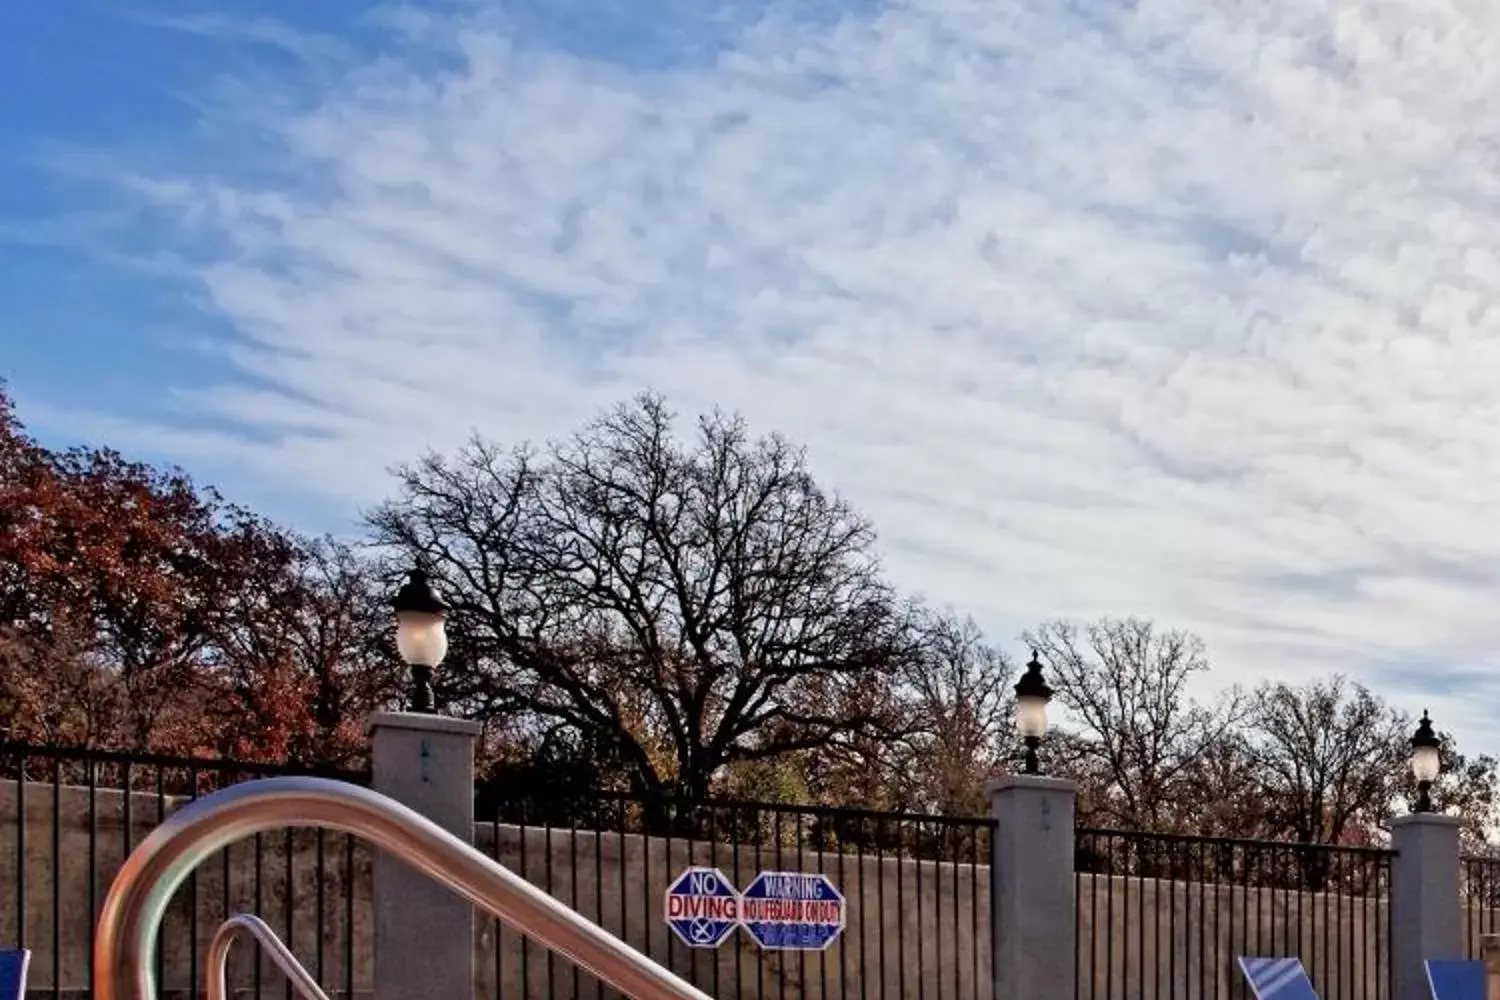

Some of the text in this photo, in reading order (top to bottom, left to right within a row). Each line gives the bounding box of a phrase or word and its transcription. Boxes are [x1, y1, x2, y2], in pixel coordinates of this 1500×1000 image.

[689, 872, 718, 895] NO
[764, 876, 824, 899] WARNING
[668, 896, 737, 919] DIVING
[743, 901, 841, 922] NO LIFEGUARD ON DUTY
